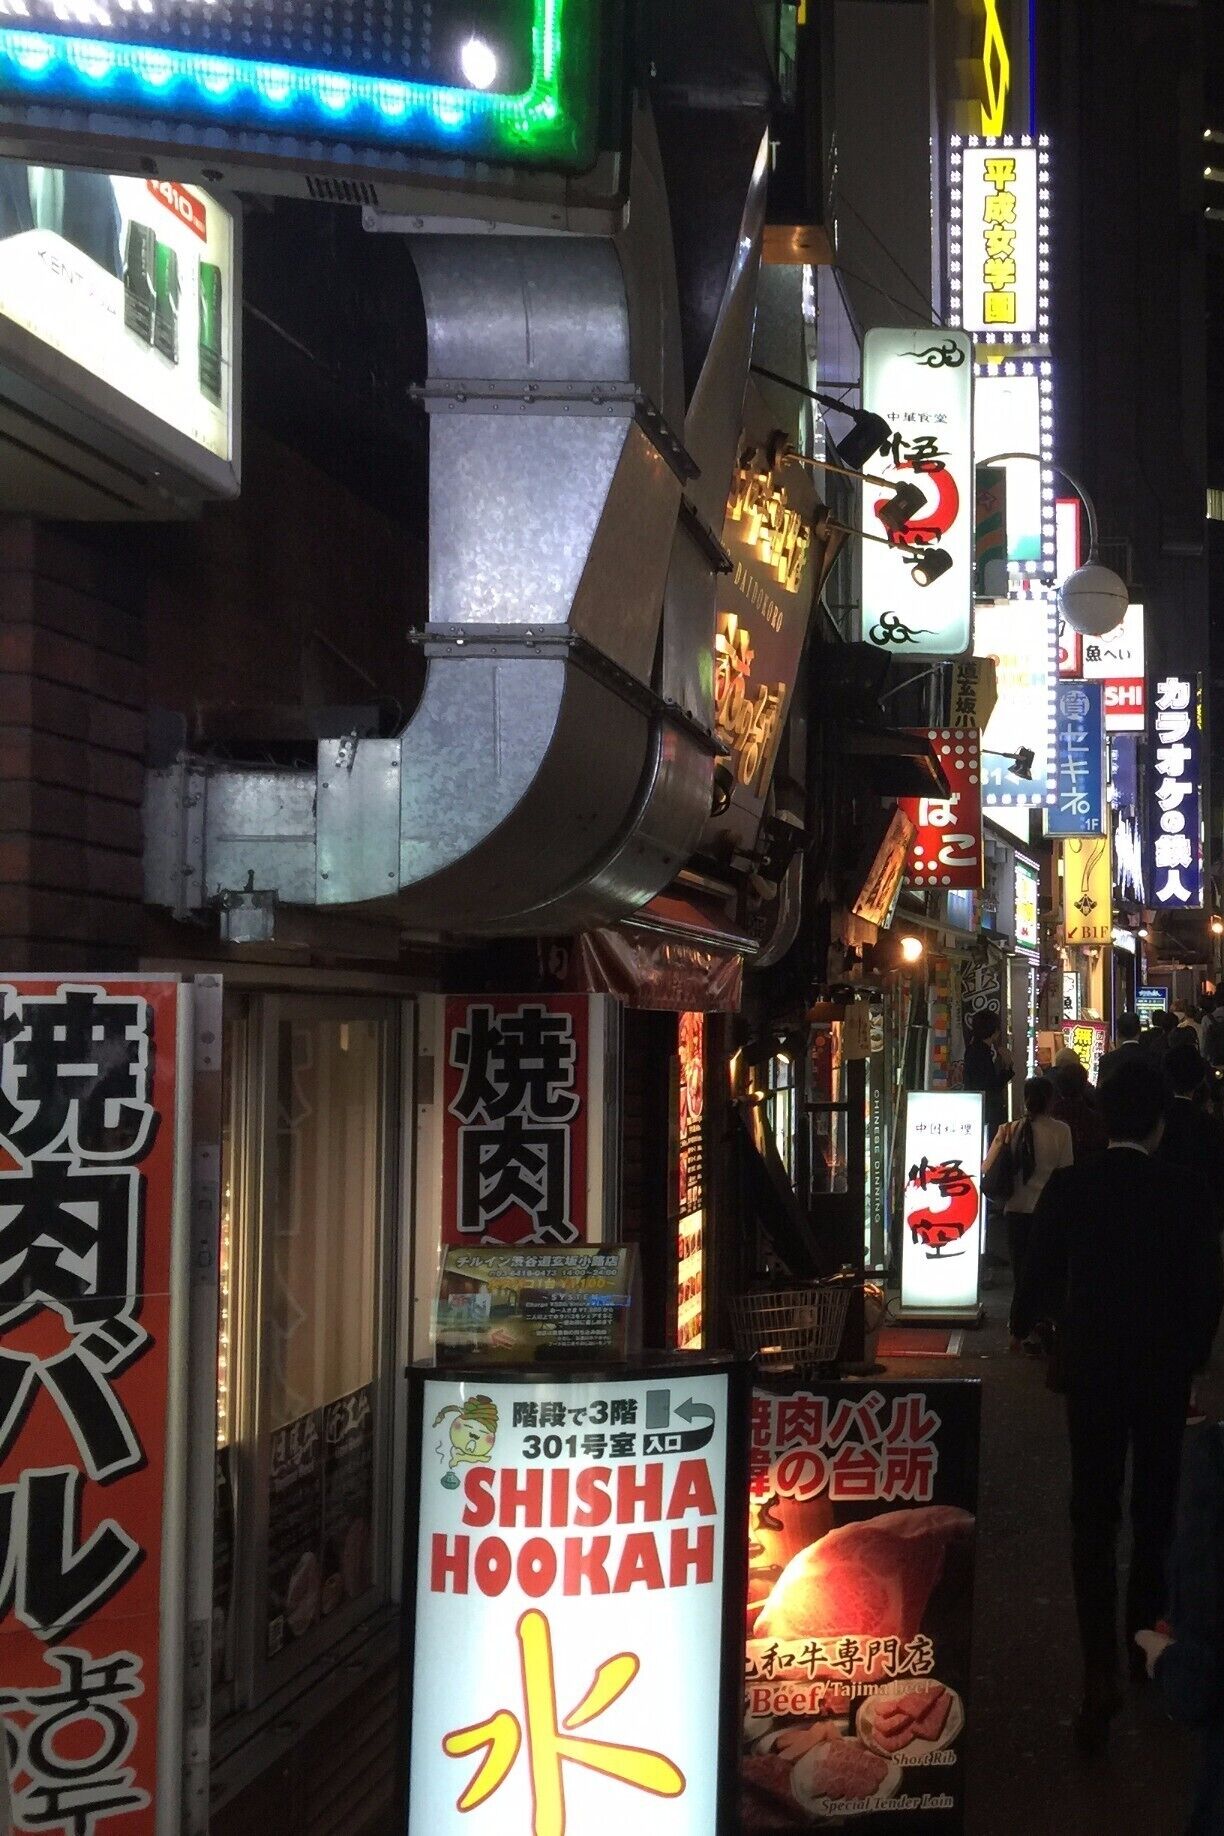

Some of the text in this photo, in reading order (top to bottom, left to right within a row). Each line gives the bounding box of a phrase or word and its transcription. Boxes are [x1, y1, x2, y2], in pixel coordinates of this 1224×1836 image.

[1060, 723, 1090, 815] セキネ
[1085, 817, 1099, 830] 1F
[1082, 926, 1108, 938] B1F
[448, 1004, 580, 1244] 焼肉
[512, 1398, 639, 1428] 階段で3階
[522, 1432, 637, 1460] 301号室
[646, 1434, 683, 1452] 入口
[461, 1458, 718, 1528] SHISHA
[430, 1524, 717, 1598] HOOKAH
[751, 1684, 823, 1716] Beef
[442, 1608, 687, 1836] 水
[890, 1749, 958, 1766] Short Rib
[820, 1798, 871, 1813] Special
[873, 1796, 920, 1810] Tender
